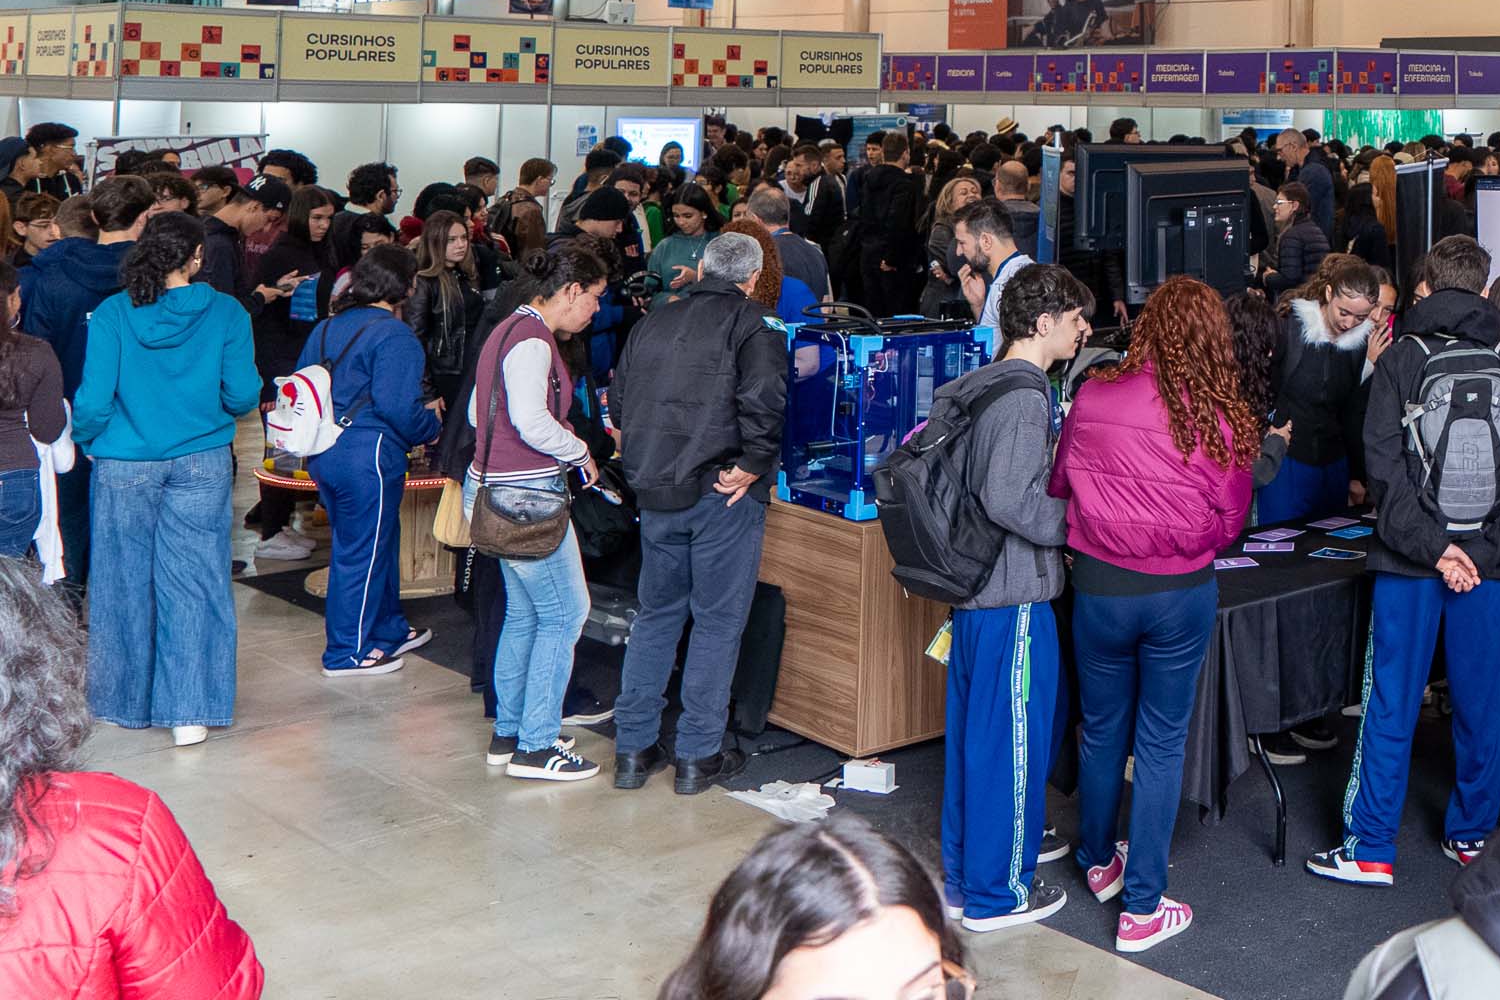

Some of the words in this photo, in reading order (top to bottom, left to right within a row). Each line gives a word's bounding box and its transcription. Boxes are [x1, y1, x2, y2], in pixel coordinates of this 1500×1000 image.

[306, 33, 396, 47] CURSINHOS
[305, 49, 396, 62] POPULARES
[576, 44, 650, 57] CURSINHOS
[800, 50, 863, 62] CURSINHOS
[575, 58, 650, 70] POPULARES
[799, 63, 863, 74] POPULARES
[1156, 64, 1190, 72] MEDICINA
[1408, 64, 1441, 73] MEDICINA
[1151, 73, 1200, 83] ENFERMAGEM
[1404, 73, 1451, 83] ENFERMAGEM
